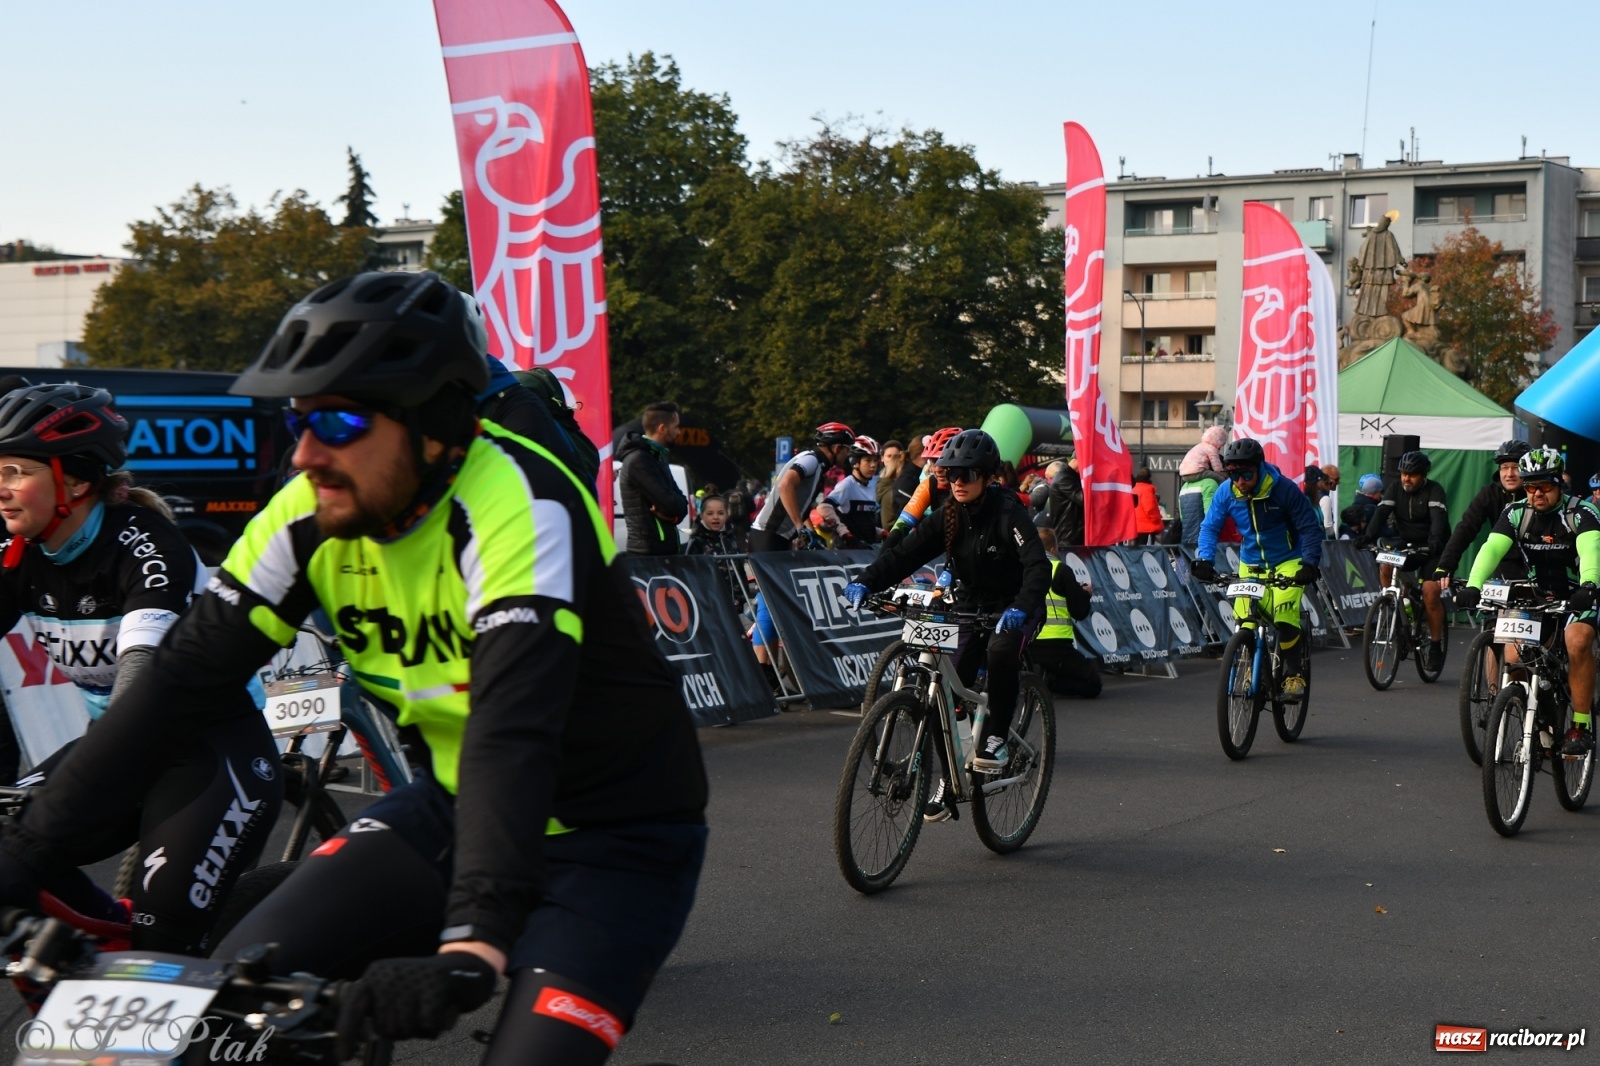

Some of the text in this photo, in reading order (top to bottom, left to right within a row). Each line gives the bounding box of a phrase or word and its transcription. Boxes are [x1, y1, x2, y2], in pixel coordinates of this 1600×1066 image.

[779, 440, 789, 460] P
[205, 501, 257, 513] MAXXIS
[1382, 554, 1401, 562] 3086
[1233, 584, 1258, 593] 3240
[914, 626, 951, 642] 3239
[1502, 621, 1534, 635] 2154
[275, 696, 325, 721] 3090
[188, 798, 252, 910] etixx
[64, 994, 178, 1033] 3184
